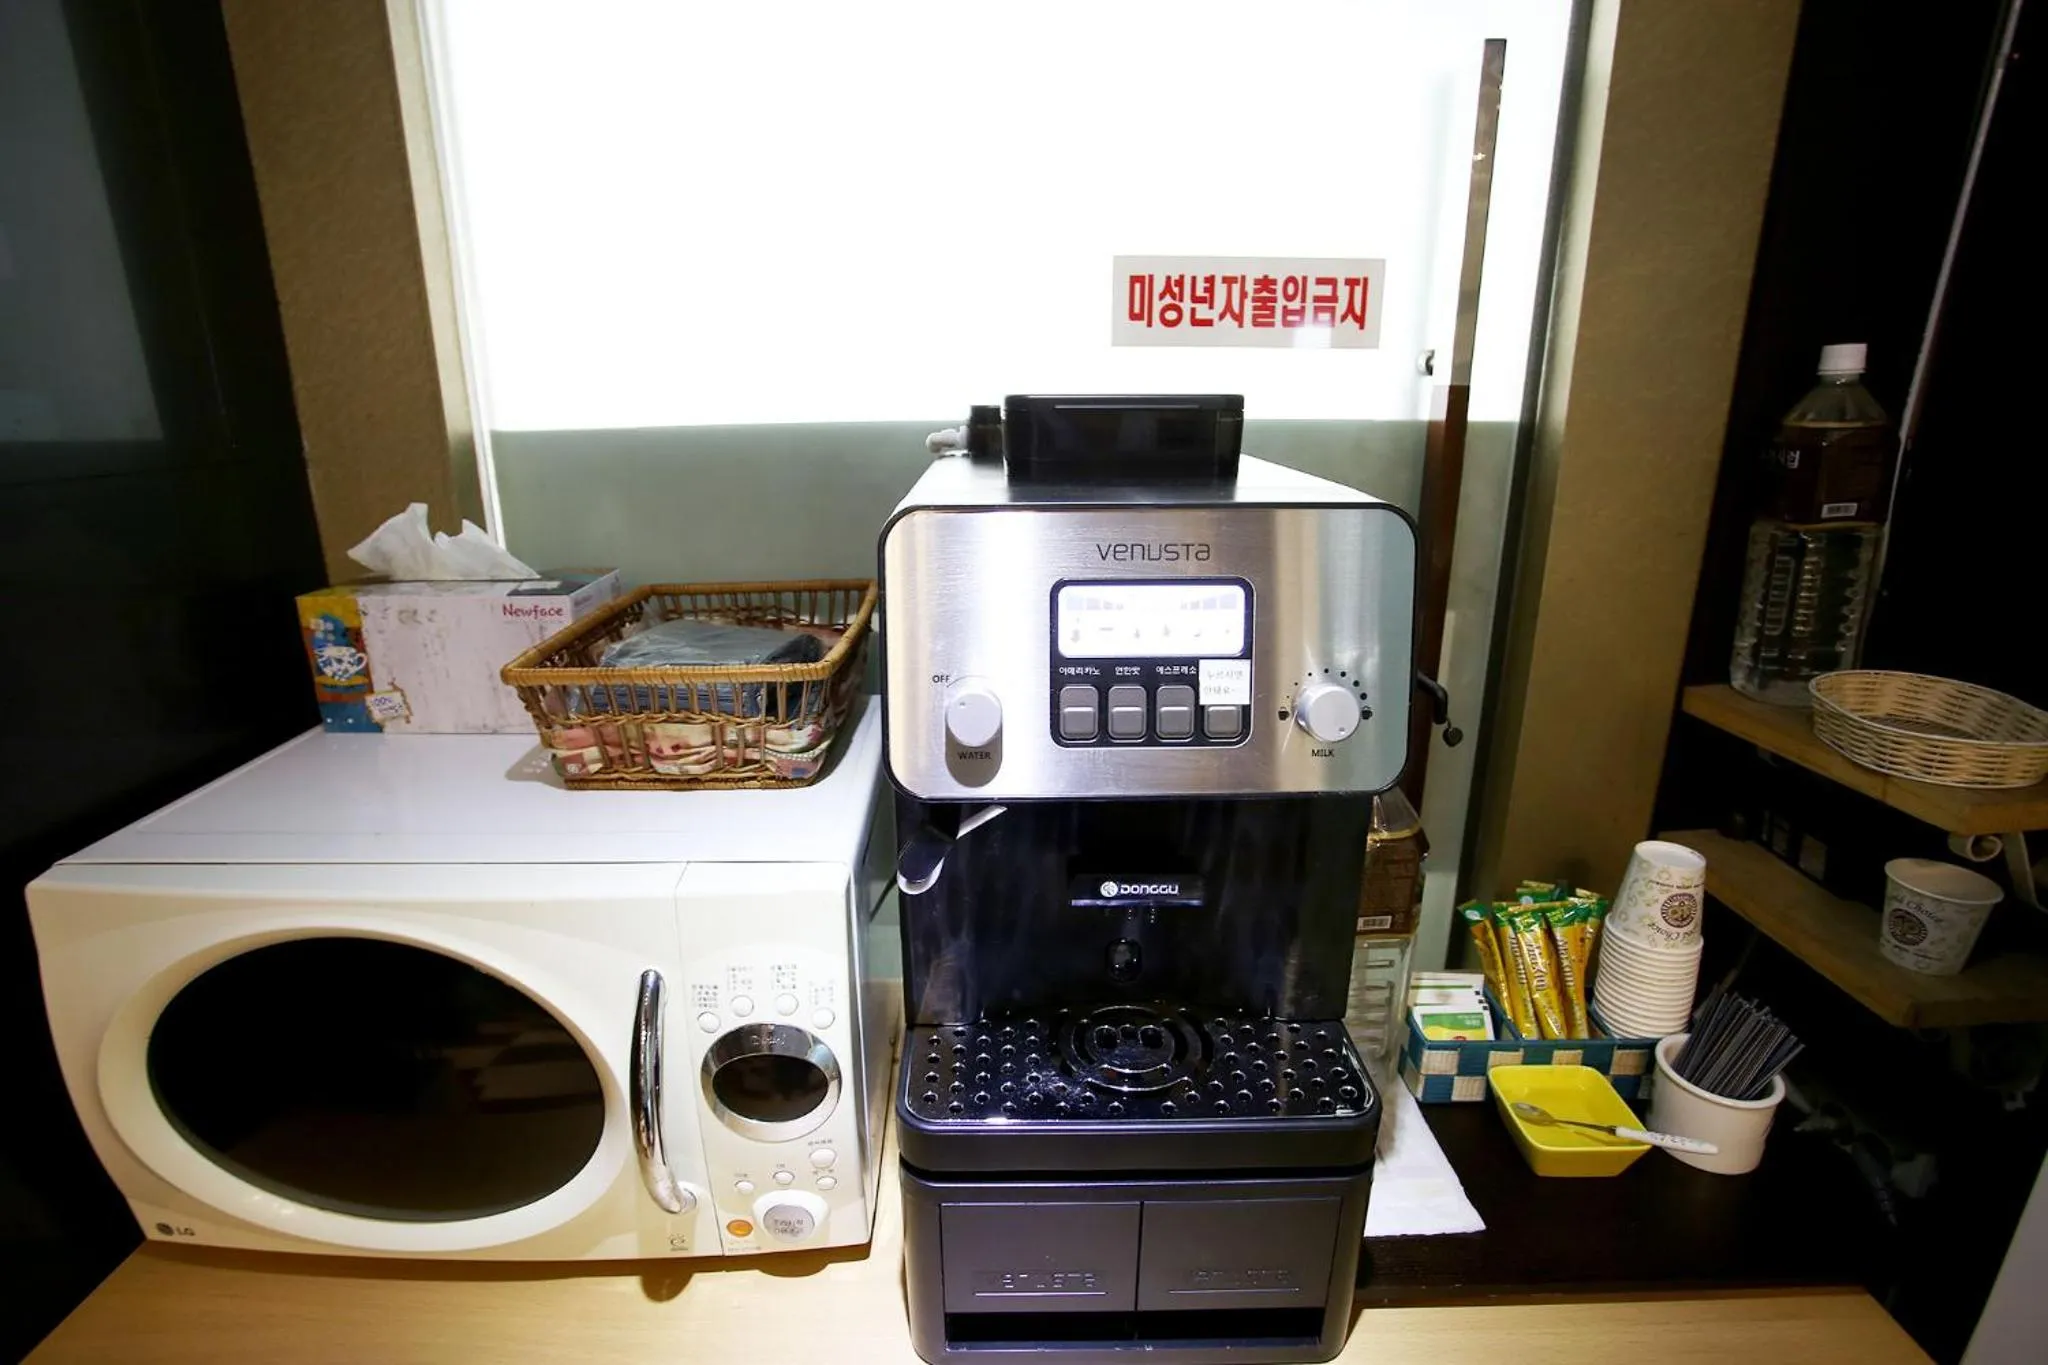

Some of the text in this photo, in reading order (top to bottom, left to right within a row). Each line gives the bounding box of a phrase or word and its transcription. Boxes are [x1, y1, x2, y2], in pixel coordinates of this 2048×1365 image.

[1127, 274, 1369, 331] 미성년자출입금지
[502, 604, 564, 619] Newface
[1058, 666, 1101, 676] 아메리카노
[1155, 664, 1197, 675] 에스프레소
[931, 675, 951, 684] OFF
[957, 751, 992, 761] WATER
[1311, 748, 1335, 758] MILK
[176, 1225, 196, 1236] LG
